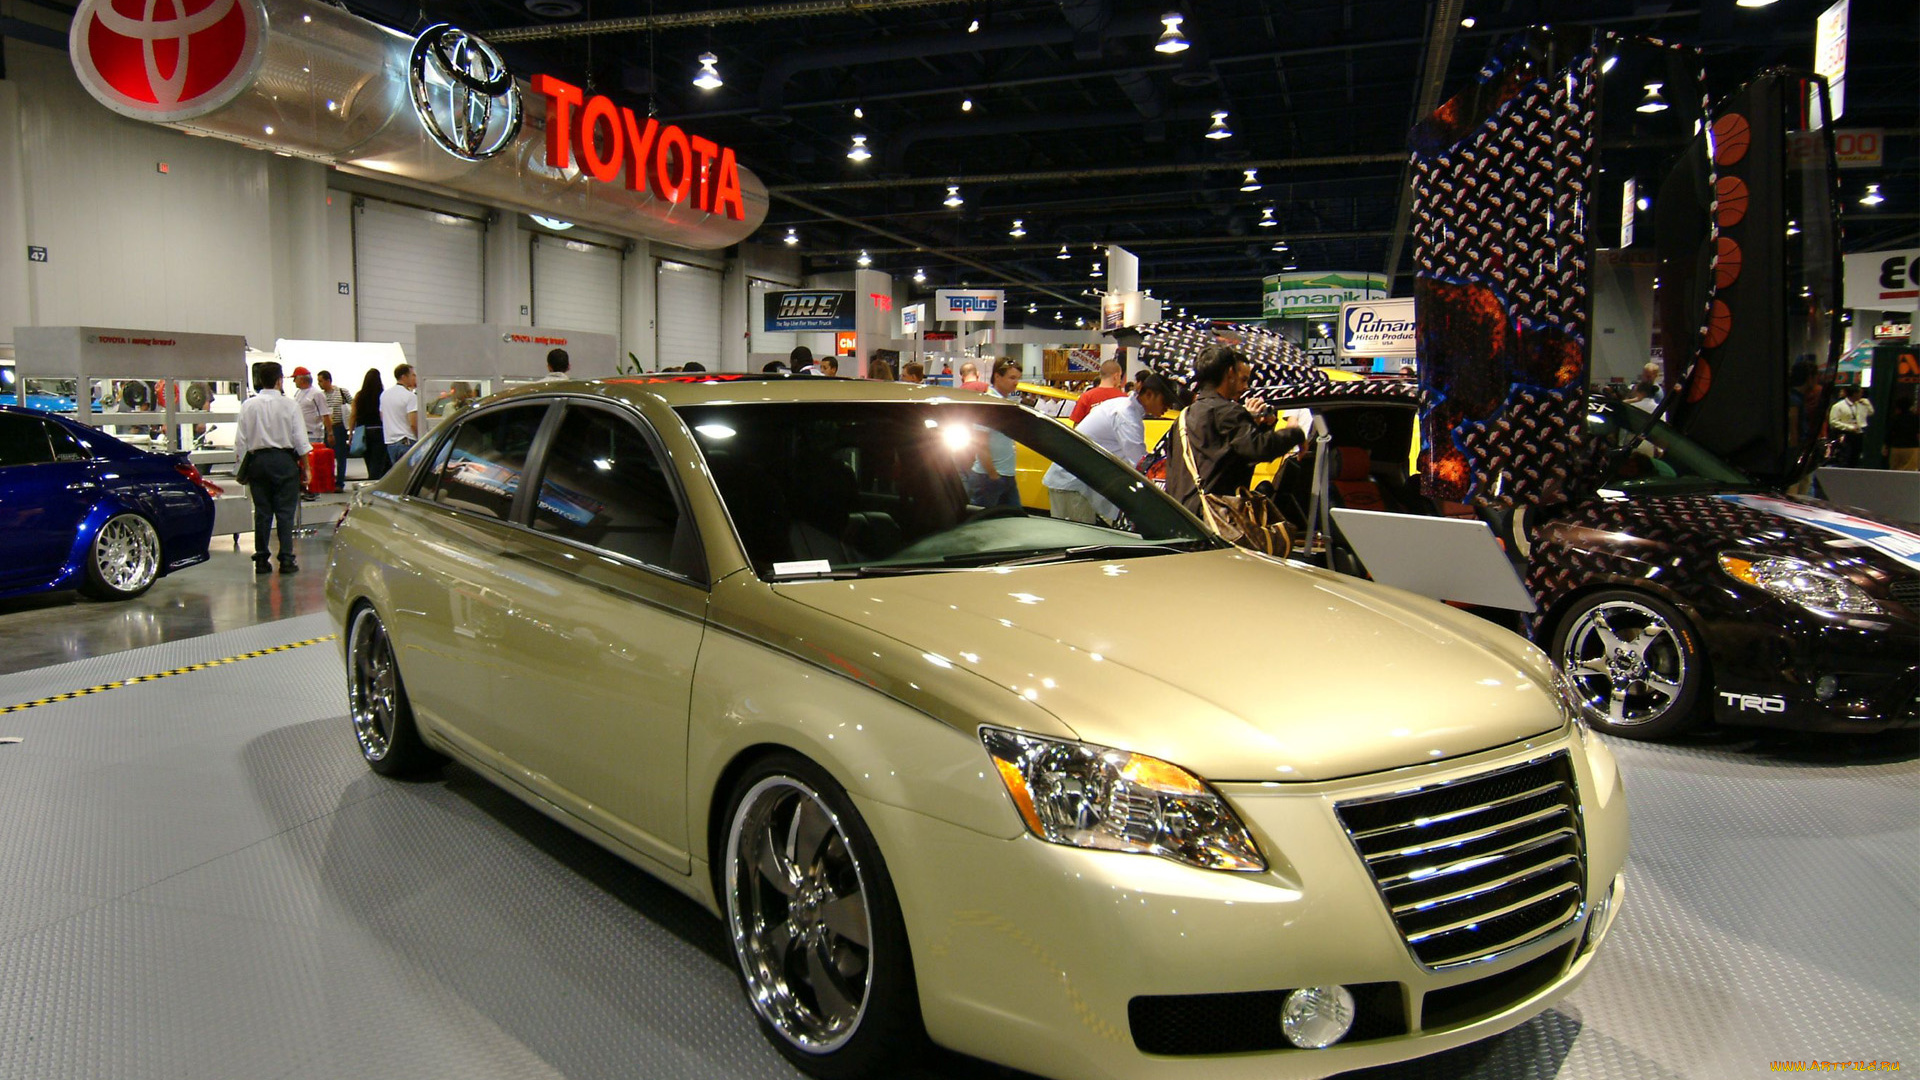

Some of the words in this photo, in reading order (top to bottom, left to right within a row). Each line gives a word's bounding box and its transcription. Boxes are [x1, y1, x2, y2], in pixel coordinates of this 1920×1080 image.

[531, 74, 745, 221] TOYOTA
[31, 252, 45, 260] 47
[1284, 291, 1361, 305] manik
[99, 336, 126, 344] TOYOTA
[1356, 333, 1379, 341] Hitch
[1720, 691, 1785, 714] TRD
